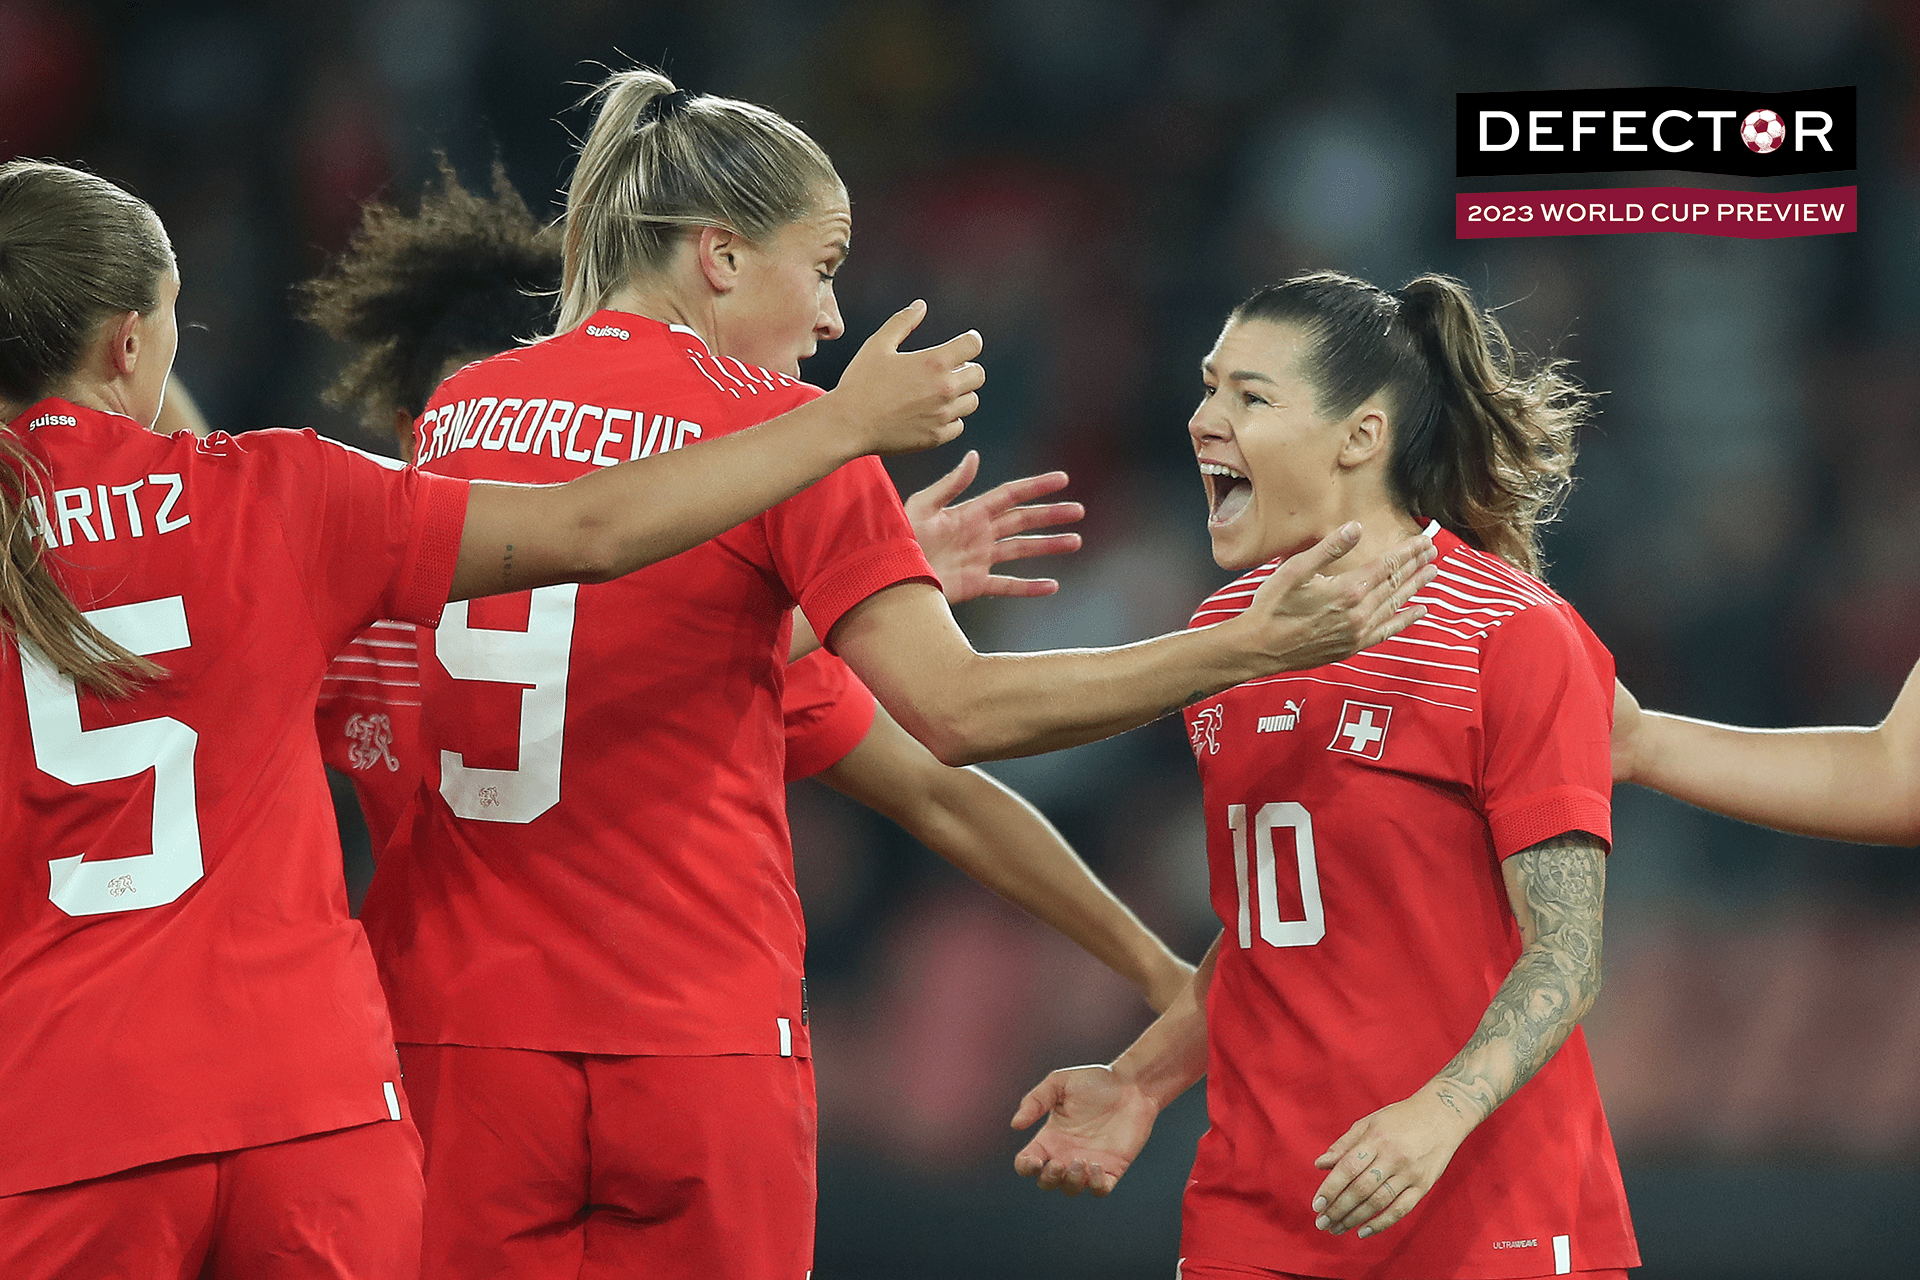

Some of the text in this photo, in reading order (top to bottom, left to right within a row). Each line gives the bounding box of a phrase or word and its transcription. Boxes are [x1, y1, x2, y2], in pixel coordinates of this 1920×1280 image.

[586, 324, 630, 341] suisse
[29, 413, 77, 431] suisse
[22, 473, 191, 549] ARITZ
[435, 583, 580, 824] 9
[1256, 714, 1296, 733] PUMA
[17, 595, 205, 917] 5
[1228, 802, 1326, 949] 10
[1492, 1239, 1538, 1249] ULTRAWEAVE
